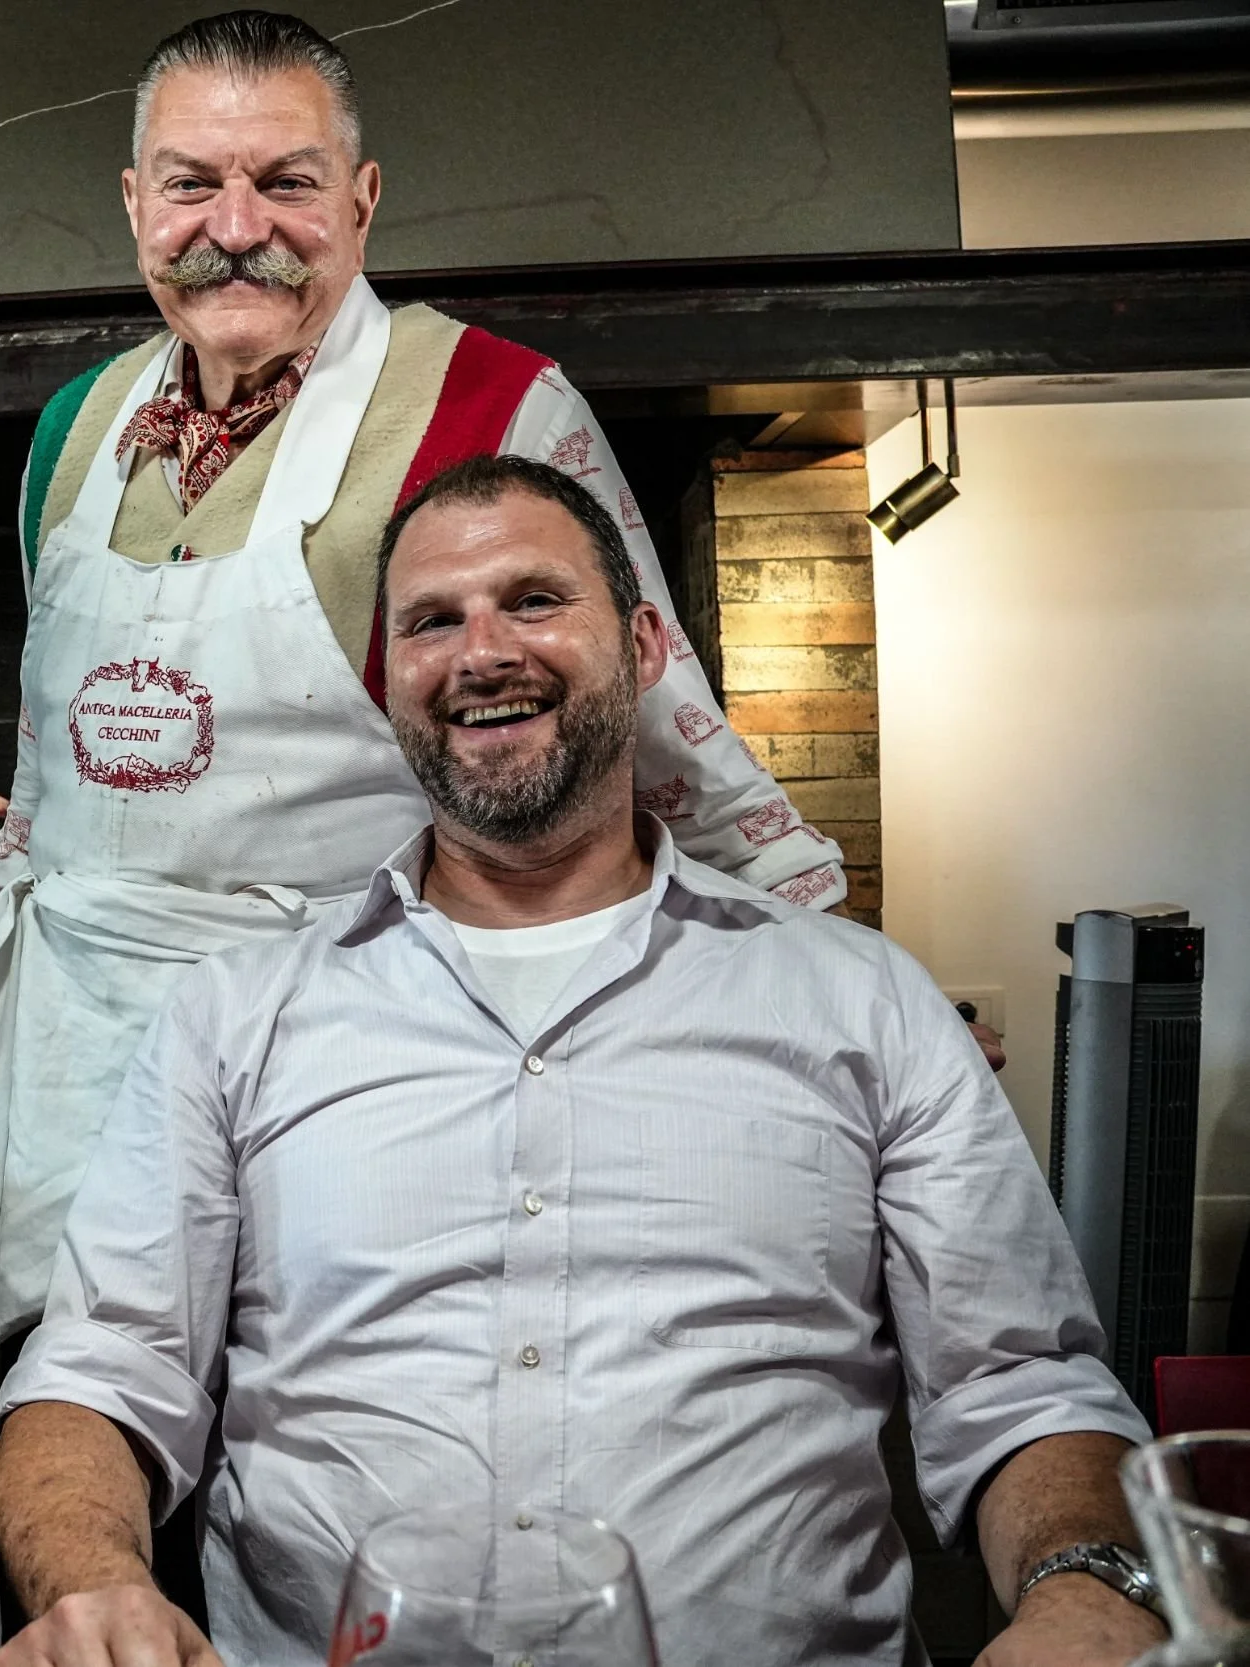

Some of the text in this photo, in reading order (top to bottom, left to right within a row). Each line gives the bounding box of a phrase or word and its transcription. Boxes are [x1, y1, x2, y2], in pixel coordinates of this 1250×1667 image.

[79, 702, 193, 720] ANTICA MACELLERIA
[97, 726, 161, 742] CECCHINI
